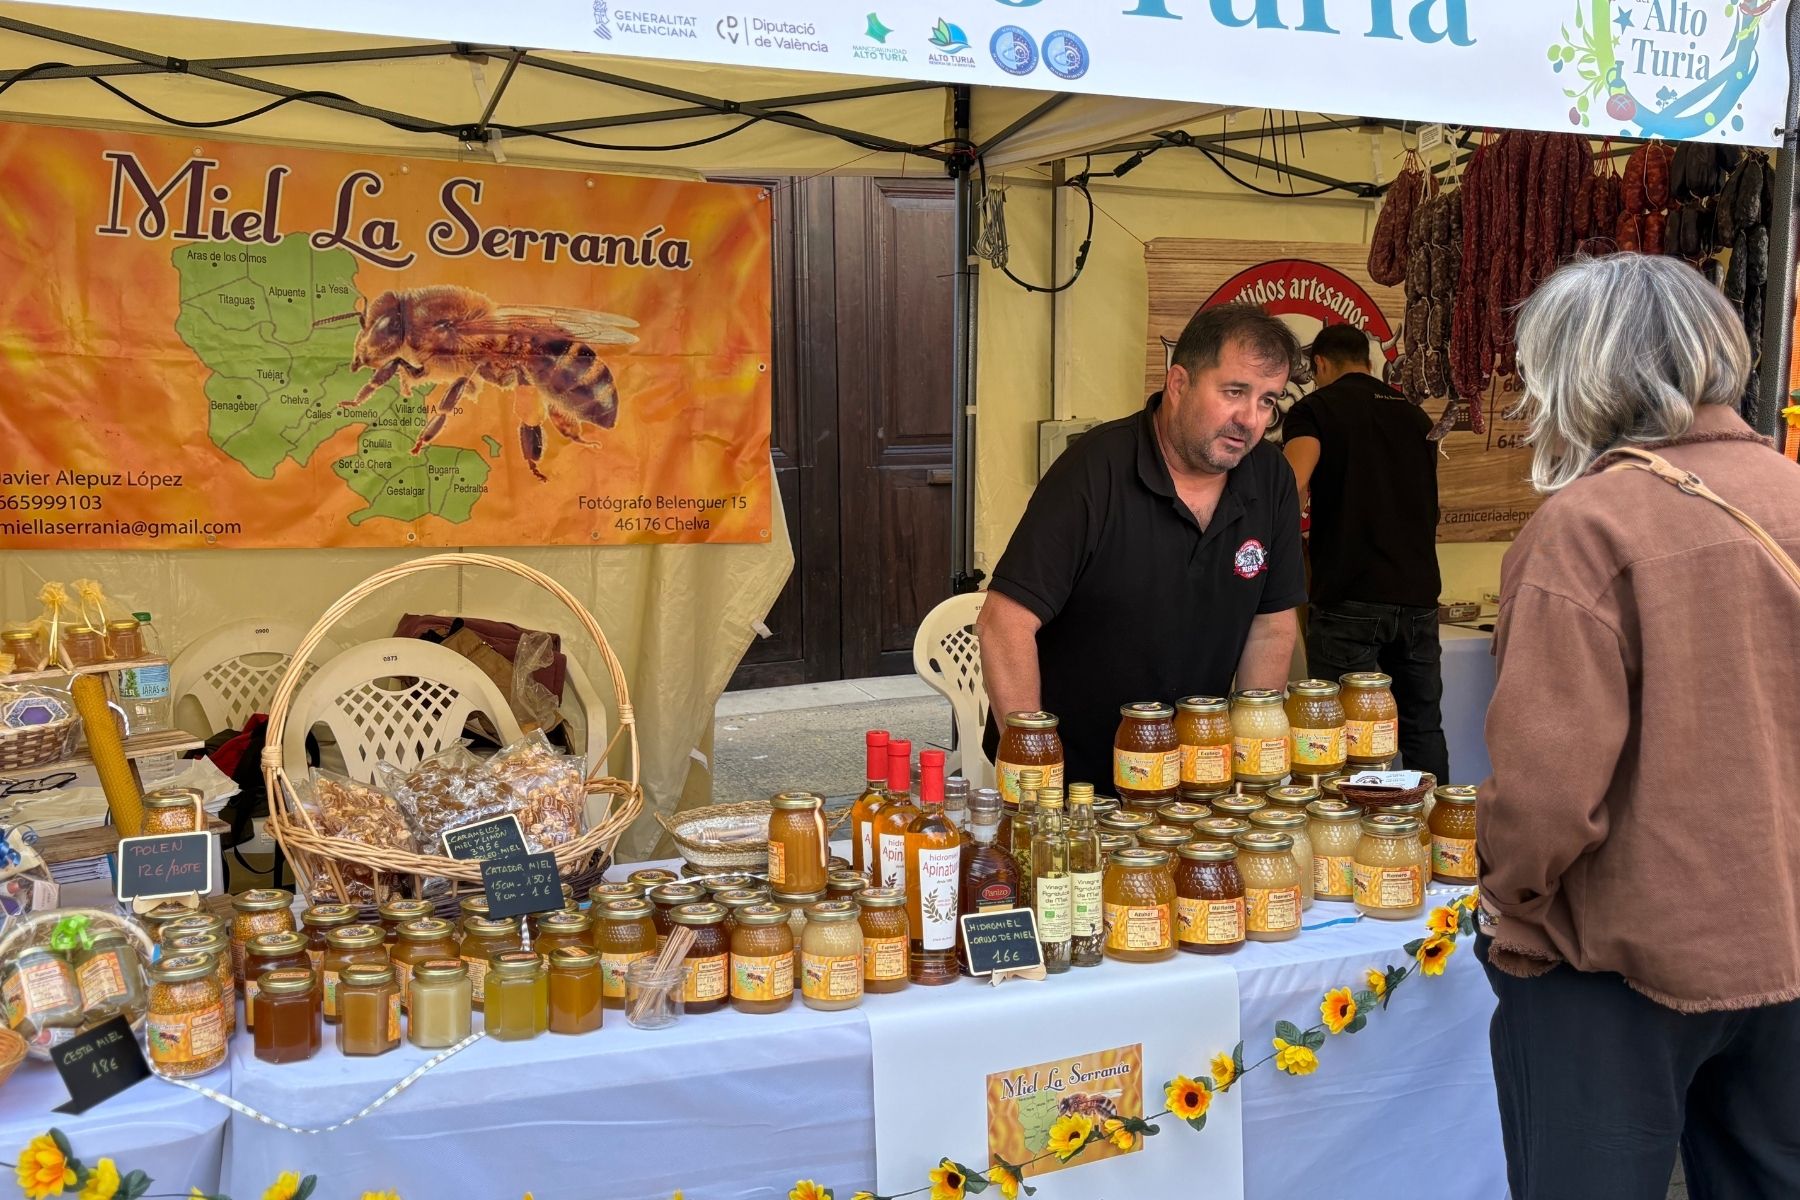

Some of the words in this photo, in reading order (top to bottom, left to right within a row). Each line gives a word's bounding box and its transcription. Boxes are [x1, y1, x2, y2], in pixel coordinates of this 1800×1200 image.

[614, 10, 697, 26] GENERALITAT
[1643, 0, 1707, 37] Alto
[616, 22, 697, 39] VALENCIANA
[752, 17, 816, 36] Diputació
[754, 35, 772, 48] de
[774, 37, 829, 53] València
[852, 45, 908, 55] MANCOMUNIDAD
[853, 50, 877, 61] ALTO
[879, 53, 909, 63] TURIA
[929, 53, 949, 62] ALTO
[950, 55, 976, 65] TURIA
[1631, 38, 1710, 81] Turia
[97, 151, 290, 246] Miel
[309, 170, 416, 270] La
[426, 176, 694, 272] Serranía
[187, 250, 208, 261] Aras
[209, 252, 222, 262] de
[223, 252, 237, 263] los
[238, 253, 268, 264] Olmos
[269, 286, 307, 298] Alpuente
[316, 284, 327, 294] La
[328, 284, 350, 295] Yesa
[218, 293, 256, 307] Titaguas
[1289, 276, 1370, 331] artesanos
[257, 369, 285, 382] Tuéjar
[280, 394, 310, 405] Chelva
[211, 400, 258, 413] Benagéber
[395, 404, 415, 415] Villar
[416, 406, 431, 415] del
[305, 409, 332, 420] Calles
[343, 408, 379, 419] Domeño
[378, 417, 399, 427] Losa
[400, 417, 413, 426] del
[362, 438, 392, 449] Chulilla
[338, 459, 353, 469] Sot
[354, 459, 366, 469] de
[367, 459, 392, 470] Chera
[428, 464, 460, 477] Bugarra
[0, 470, 50, 486] avier
[55, 470, 122, 489] Alepuz
[127, 472, 183, 490] López
[386, 486, 426, 498] Gestalgar
[453, 483, 489, 494] Pedralba
[578, 495, 652, 513] Fotógrafo
[656, 495, 728, 512] Belenguer
[731, 496, 747, 509] 15
[614, 517, 661, 532] 46176
[664, 517, 710, 531] Chelva
[130, 840, 183, 857] POLEN
[454, 841, 473, 851] MIEL
[474, 837, 481, 847] Y
[500, 843, 521, 855] MIEL
[485, 863, 524, 876] CATADOR
[528, 860, 552, 870] MIEL
[63, 1045, 94, 1065] CESTA
[97, 1031, 123, 1049] MIEL
[1000, 1071, 1038, 1100] Miel
[1043, 1067, 1066, 1092] La
[1068, 1062, 1131, 1085] Serranía
